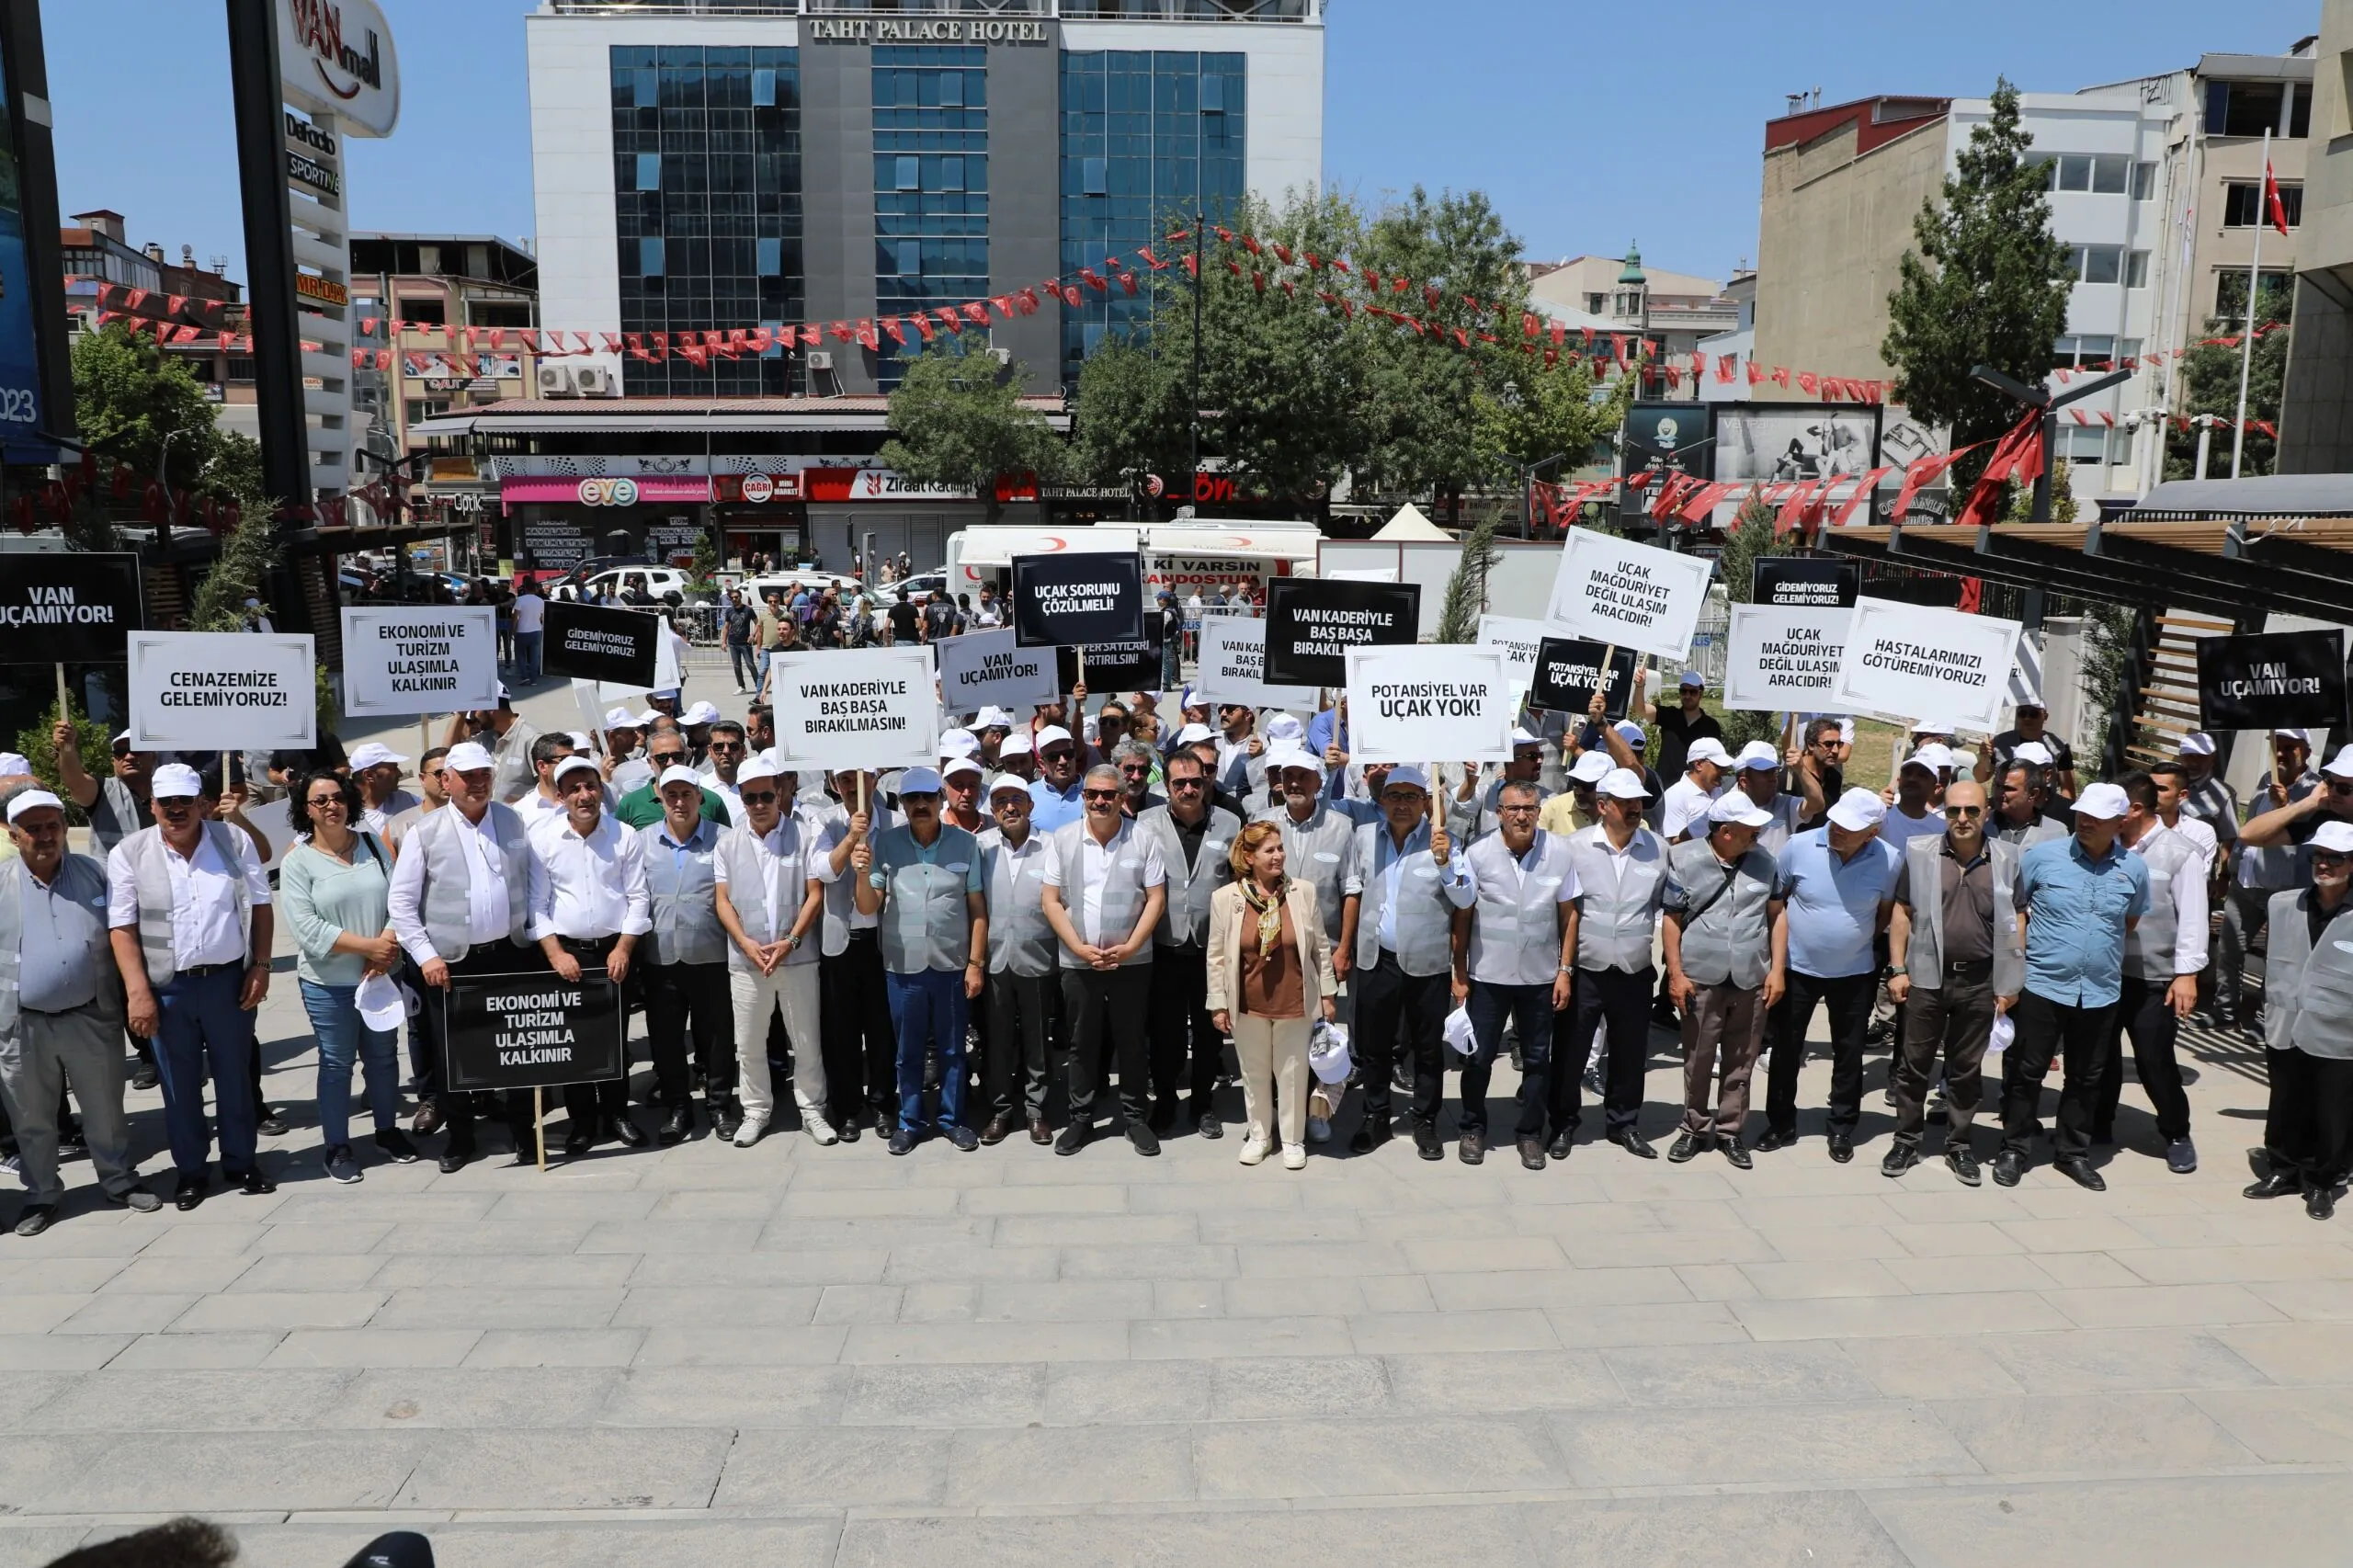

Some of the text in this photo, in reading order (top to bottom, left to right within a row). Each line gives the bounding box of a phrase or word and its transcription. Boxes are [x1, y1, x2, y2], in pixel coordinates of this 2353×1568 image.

[810, 19, 1048, 41] TAHT PALACE HOTEL
[286, 112, 335, 156] DeFacto
[0, 388, 37, 424] 023
[579, 479, 637, 506] eve
[885, 477, 926, 494] Ziraat
[1040, 487, 1131, 497] TAHT PALACE HOTEL
[454, 493, 483, 517] Optik
[1878, 496, 1946, 516] OSANLI
[1181, 561, 1260, 572] VARSIN
[1617, 560, 1651, 580] UÇAK
[1034, 582, 1120, 602] UÇAK SORUNU
[1590, 569, 1670, 600] MAĞDURİYET
[1775, 581, 1837, 594] GİDEMİYORUZ
[28, 586, 74, 605] VAN
[1586, 584, 1667, 616] DEĞİL ULAŞIM
[1772, 593, 1839, 605] GELEMİYORUZ!
[1042, 596, 1114, 616] ÇÖZÜLMELİ!
[1591, 602, 1653, 628] ARACIDIR!
[1293, 608, 1393, 626] VAN KADERİYLE
[379, 621, 465, 640] EKONOMİ VE
[567, 627, 634, 646] GİDEMİYORUZ
[1310, 626, 1373, 643] BAŞ BAŞA
[1787, 628, 1821, 642] UÇAK
[396, 641, 449, 657] TURİZM
[564, 638, 635, 656] GELEMİYORUZ!
[1071, 643, 1102, 653] SFER
[1222, 641, 1244, 652] VAN
[1293, 642, 1346, 656] BIRAKIL
[1492, 639, 1539, 652] POTANSİYE
[1761, 641, 1845, 657] MAĞDURİYET
[1874, 638, 1983, 669] HASTALARIMIZI
[388, 659, 460, 677] ULAŞIMLA
[983, 653, 1013, 668] VAN
[1083, 653, 1139, 666] ARTIRILSIN!
[1235, 654, 1256, 668] BAŞ
[1759, 655, 1794, 671] DEĞİL
[170, 669, 278, 687] CENAZEMİZE
[960, 665, 1039, 685] UÇAMIYOR!
[1222, 666, 1264, 679] BIRAKIL
[1548, 662, 1620, 680] POTANSİYEL AR
[1862, 652, 1986, 687] GÖTÜREMİYORUZ!
[2249, 662, 2287, 679] VAN
[392, 676, 457, 693] KALKINIR
[801, 678, 906, 698] VAN KADERİYLE
[1551, 671, 1581, 687] UÇAK
[1768, 675, 1832, 688] ARACIDIR!
[2221, 677, 2321, 699] UÇAMIYOR!
[160, 689, 288, 707] GELEMİYORUZ!
[1371, 680, 1487, 699] POTANSİYEL VAR
[821, 699, 888, 718] BAŞ BAŞA
[1380, 699, 1482, 721] UÇAK YOK!
[805, 715, 906, 734] BIRAKILMASIN!
[486, 990, 582, 1012] EKONOMİ VE
[505, 1010, 564, 1028] TURİZM
[495, 1028, 574, 1050] ULAŞIMLA
[500, 1047, 572, 1065] KALKINIR
